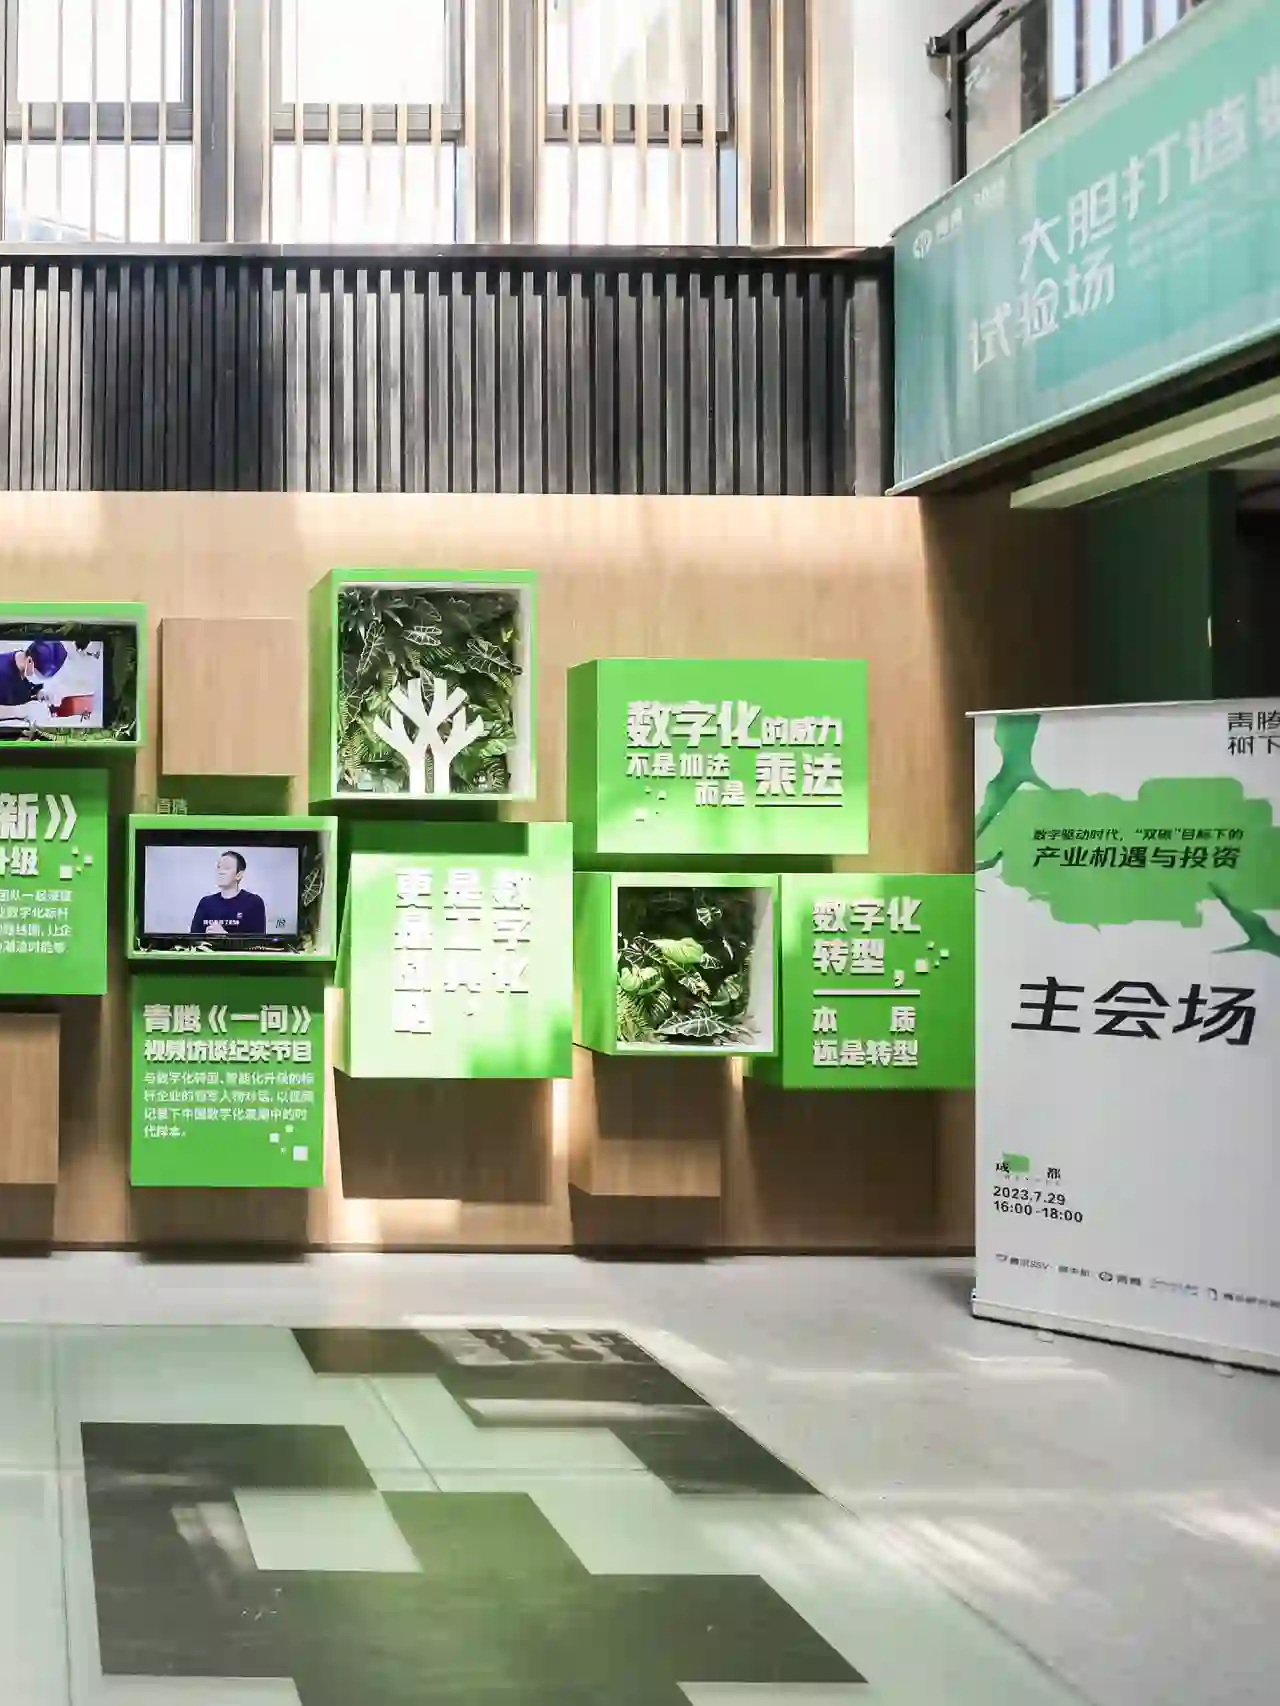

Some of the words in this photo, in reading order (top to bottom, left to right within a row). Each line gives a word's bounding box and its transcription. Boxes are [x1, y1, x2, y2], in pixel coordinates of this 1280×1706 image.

[626, 753, 730, 779] 不是加法
[756, 753, 843, 796] 乘法
[694, 780, 745, 807] 而是
[1032, 846, 1241, 869] 产业机遇与投资
[813, 896, 922, 933] 数字化
[143, 1004, 312, 1034] 青腾《一问》
[1011, 977, 1257, 1046] 主会场
[993, 1185, 1066, 1206] 2023.7.29
